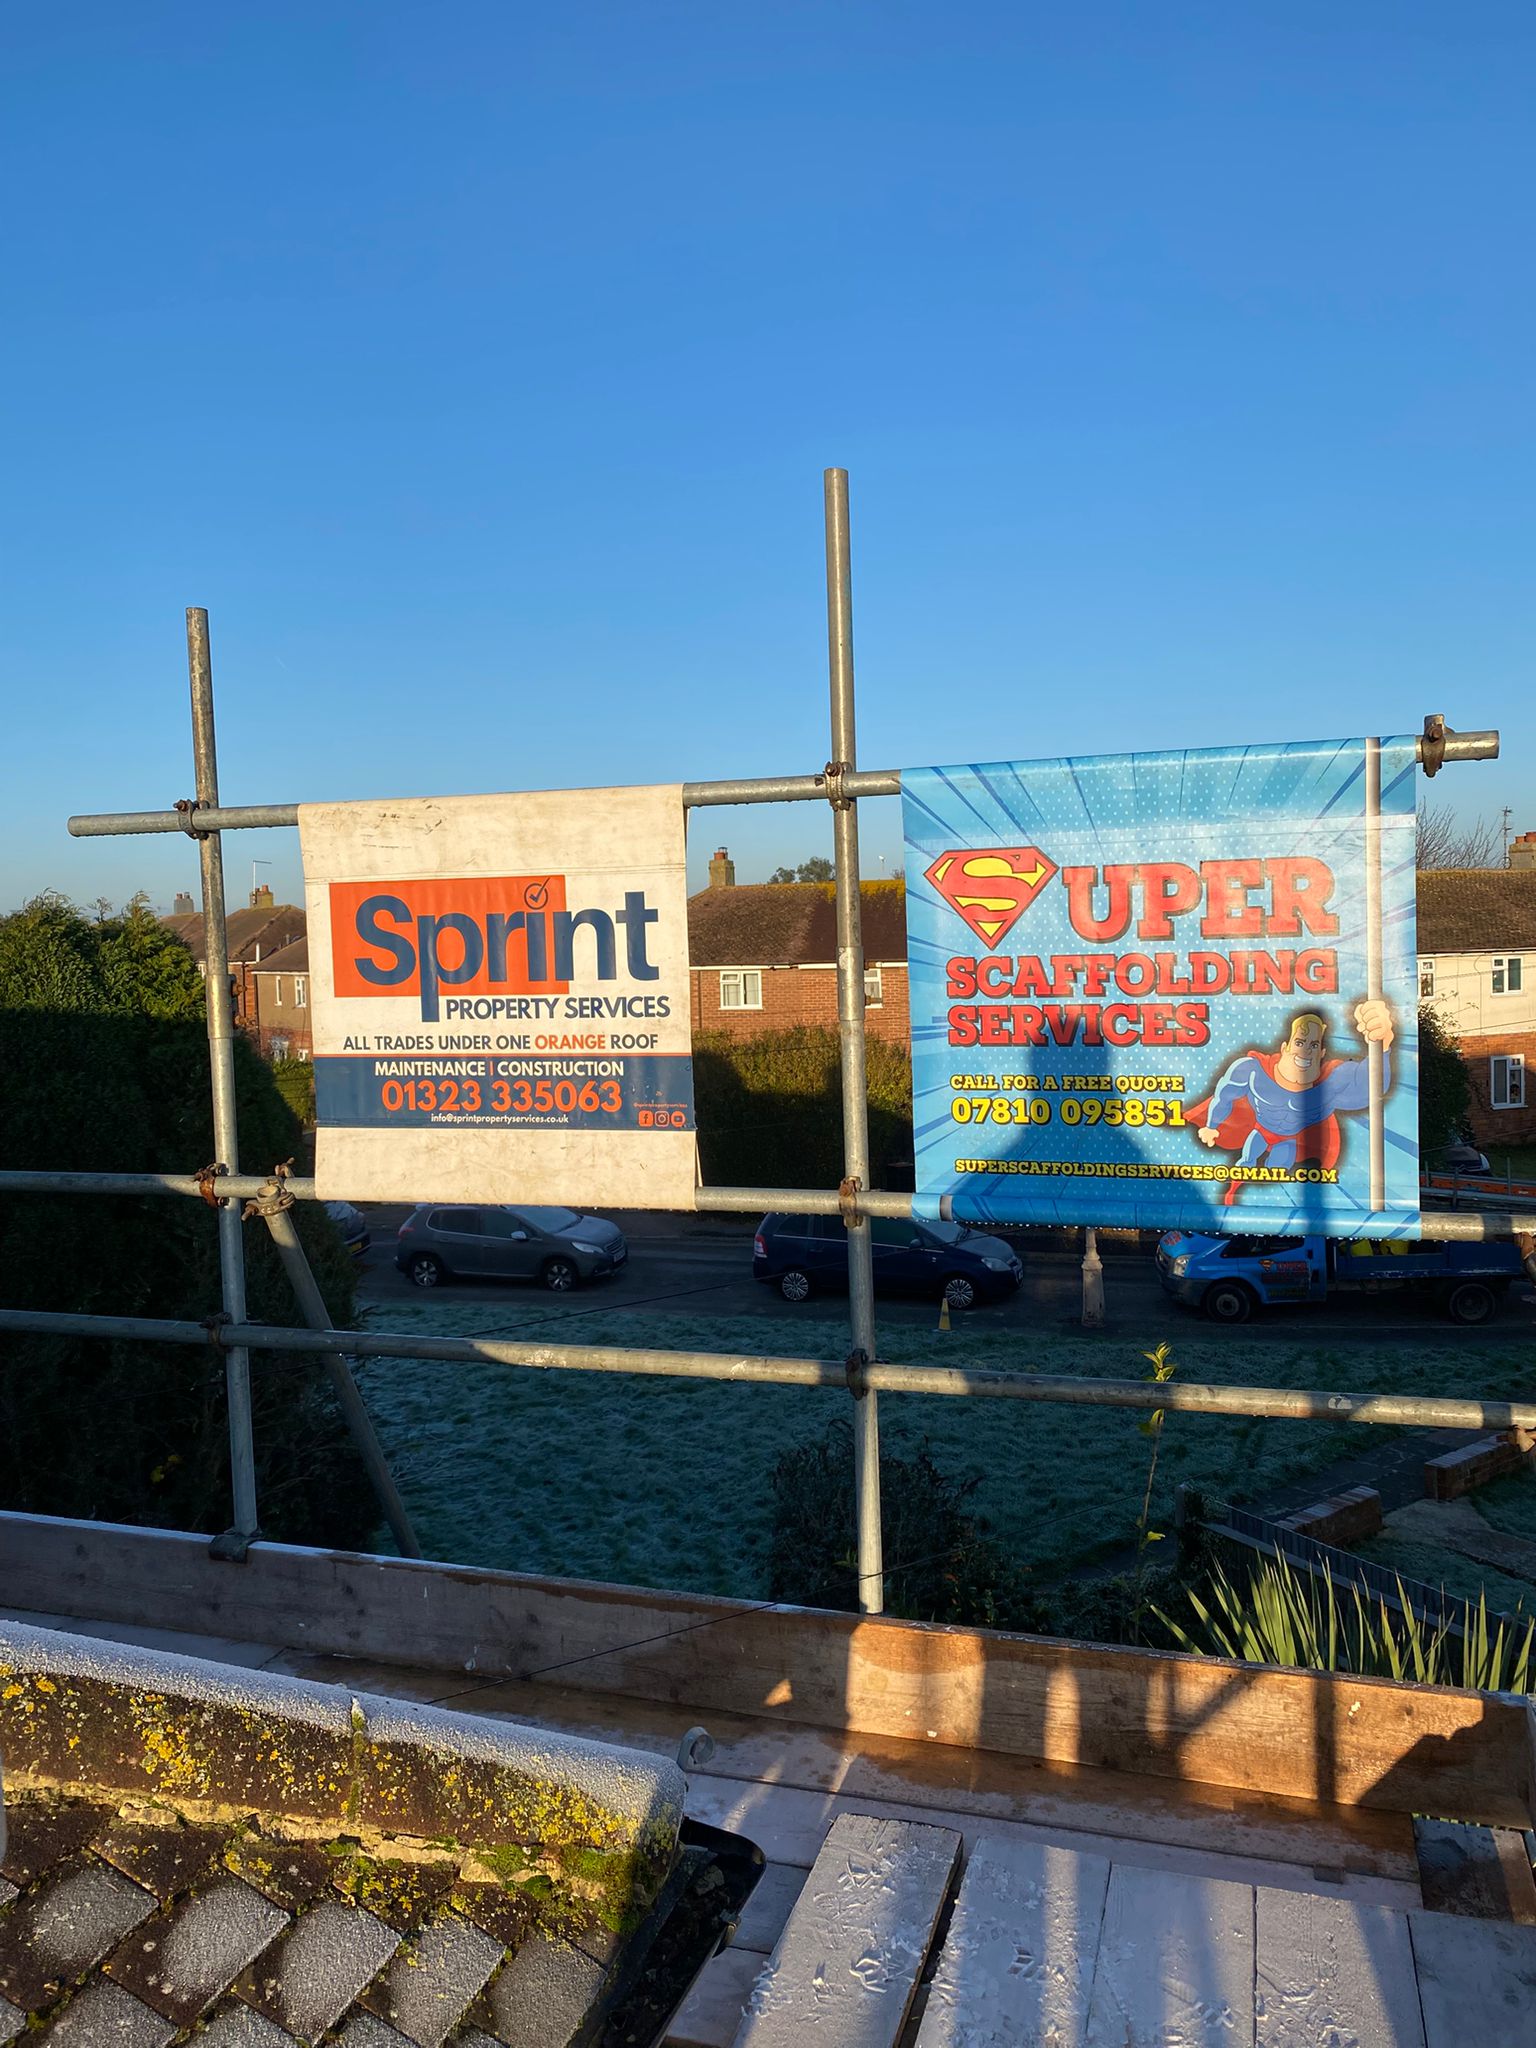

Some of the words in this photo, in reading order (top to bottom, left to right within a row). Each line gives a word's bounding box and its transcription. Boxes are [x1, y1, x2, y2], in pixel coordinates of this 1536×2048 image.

[354, 878, 660, 1023] Sprint
[946, 948, 1339, 998] SCAFFOLDING
[446, 997, 563, 1020] PROPERTY
[564, 995, 671, 1019] SERVICES
[947, 1002, 1211, 1047] SERVICES
[343, 1036, 370, 1051] ALL
[374, 1035, 434, 1051] TRADES
[438, 1034, 493, 1050] UNDER
[496, 1034, 531, 1050] ONE
[534, 1034, 606, 1050] ORANGE
[610, 1033, 659, 1049] ROOF
[375, 1061, 486, 1076] MAINTENANCE
[497, 1061, 624, 1076] CONSTRUCTION
[381, 1079, 482, 1112] 01323
[491, 1079, 623, 1112] 335063
[950, 1074, 1000, 1091] CALL
[1001, 1074, 1040, 1091] FOR
[1043, 1075, 1059, 1091] A
[1062, 1075, 1113, 1092] FREE
[1115, 1075, 1185, 1094] QUOTE
[430, 1113, 569, 1125] info@sprintpropertyservices.co.uk
[951, 1097, 1051, 1125] 07810
[1060, 1097, 1187, 1126] 095851
[955, 1158, 1339, 1184] SUPERSCAFFOLDINGSERVICES@GMAIL.COM
